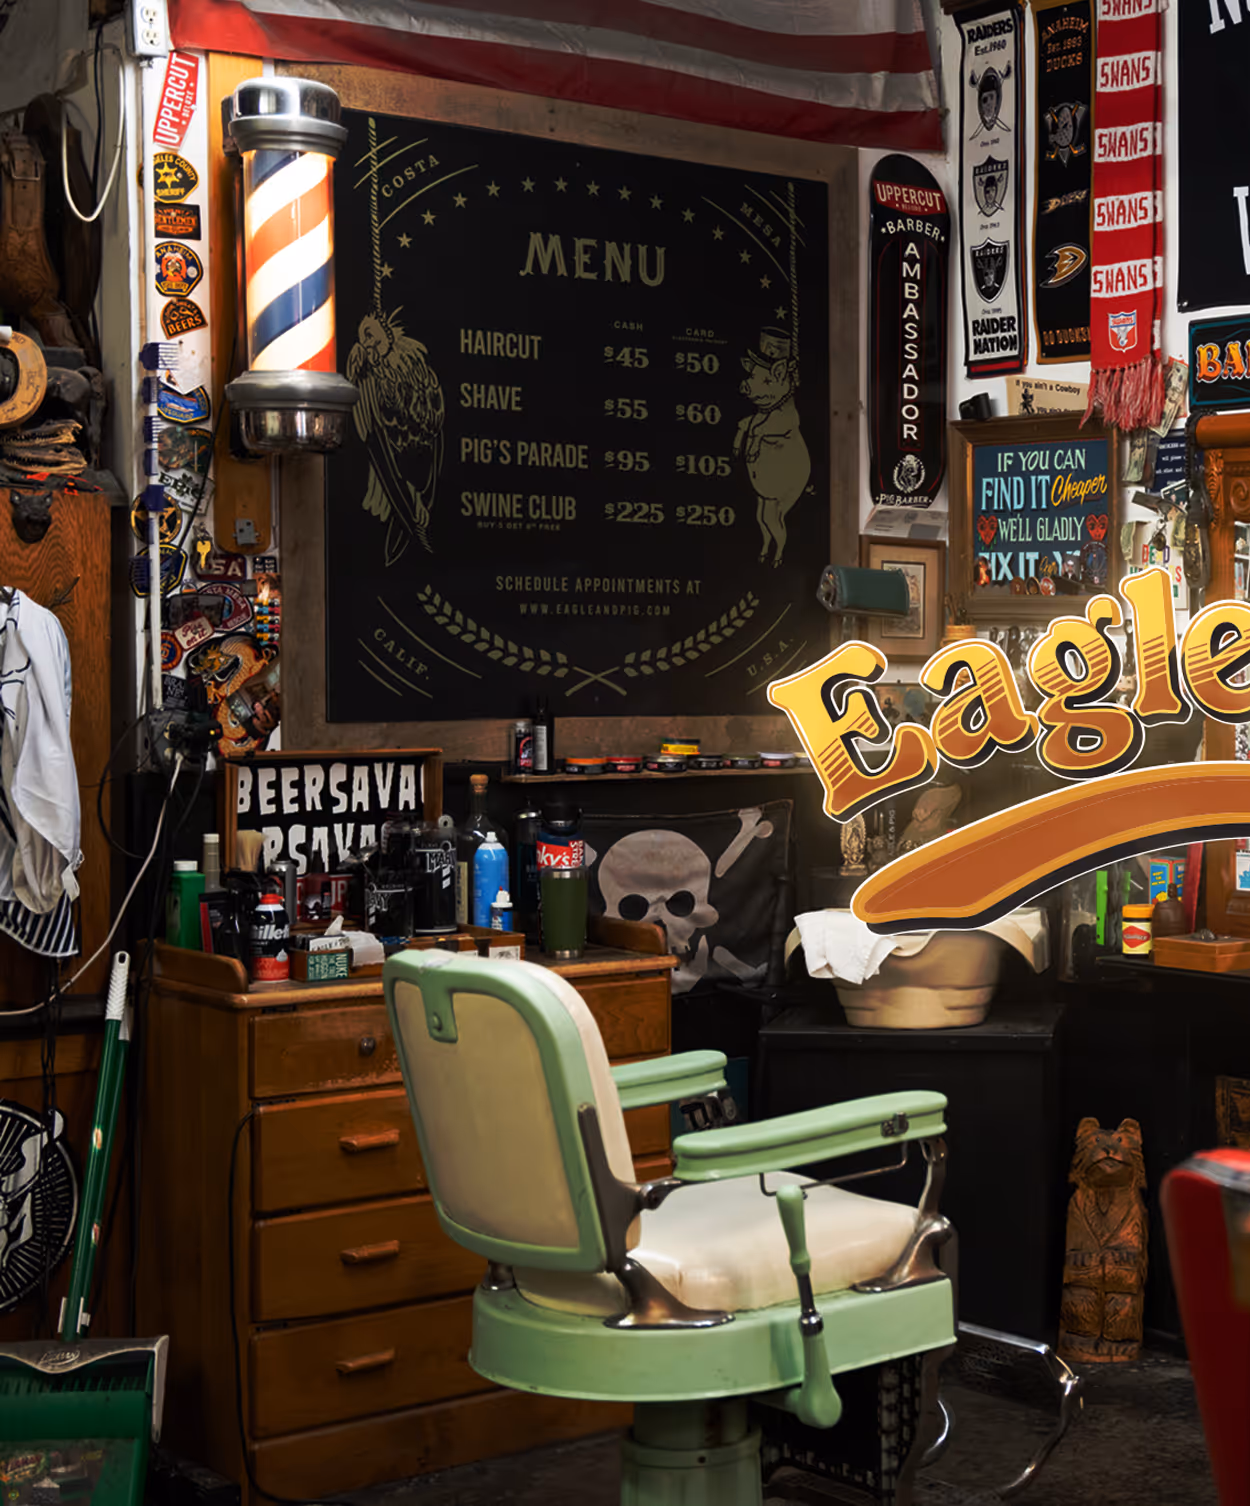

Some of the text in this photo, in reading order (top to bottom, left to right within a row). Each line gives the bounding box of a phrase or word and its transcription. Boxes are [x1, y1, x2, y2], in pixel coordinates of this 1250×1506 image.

[967, 18, 1014, 44] RAIDERS
[1041, 17, 1089, 42] ANAHEIM
[1046, 52, 1083, 73] DUCKS
[1100, 57, 1150, 88] SWANS
[155, 53, 196, 145] UPPERCUT
[1098, 126, 1149, 158] SWANS
[175, 158, 197, 181] COUNTY
[381, 153, 441, 198] COSTA
[876, 183, 942, 211] UPPERCUT
[1096, 196, 1149, 227] SWANS
[739, 202, 783, 249] MESA
[886, 218, 941, 242] BARBER
[155, 246, 193, 261] ANAHEIM
[519, 232, 667, 288] MENU
[1092, 263, 1148, 295] SWANS
[167, 316, 203, 335] BEERS
[613, 320, 643, 332] CASH
[685, 327, 715, 338] CARD
[973, 316, 1016, 336] RAIDER
[460, 328, 720, 375] HAIRCUT $45 $50
[902, 242, 921, 441] AMBASSADOR
[973, 335, 1017, 355] NATION
[460, 383, 722, 425] SHAVE $55 $60
[1055, 383, 1081, 395] Cowboy
[460, 437, 732, 477] PIG'S PARADE $95 $105
[997, 449, 1086, 473] IF YOU CAN
[981, 473, 1108, 511] FIND IT Cheaper
[461, 490, 737, 527] SWINE CLUB $225 $250
[998, 516, 1085, 543] WE'LL GLADLY
[1018, 551, 1040, 581] IT
[496, 575, 701, 595] SCHEDULE APPOINTMENTS AT
[519, 603, 672, 617] WWW.EAGLEANDPIG.COM
[373, 627, 430, 681] CALIF.
[746, 636, 794, 677] U.S.A.
[237, 762, 425, 815] BEERSAVA
